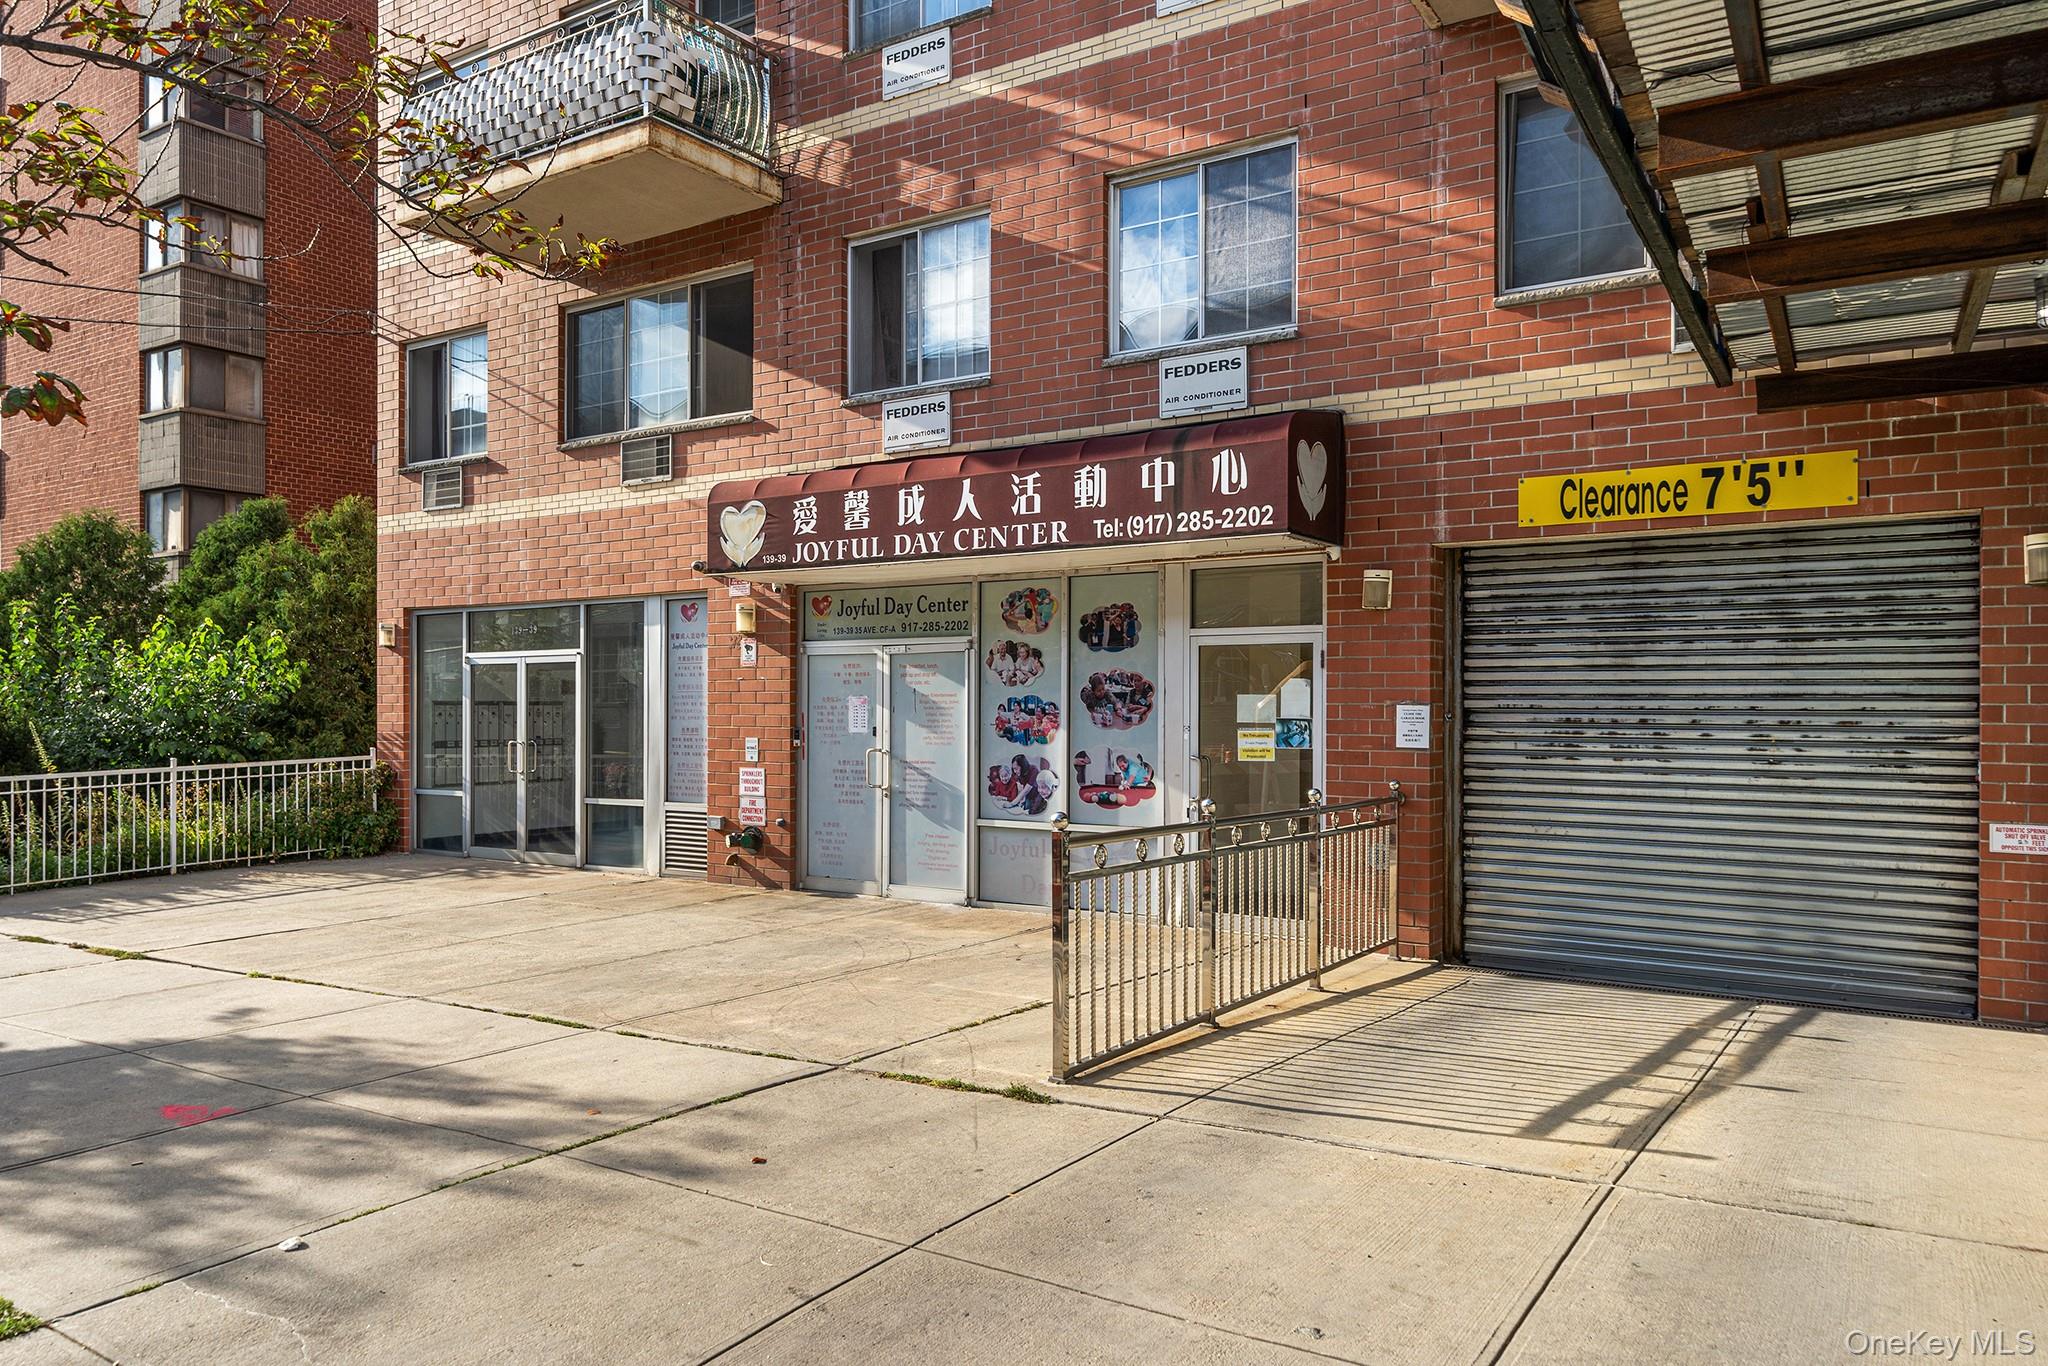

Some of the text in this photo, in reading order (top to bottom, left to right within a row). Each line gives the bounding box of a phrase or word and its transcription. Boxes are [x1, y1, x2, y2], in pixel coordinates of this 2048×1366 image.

[886, 37, 946, 65] FEDDERS
[886, 64, 945, 87] AIR CONDITIONER
[1164, 357, 1242, 379] FEDDERS
[1164, 388, 1242, 404] AIR CONDITIONER
[886, 401, 946, 420] FEDDERS
[900, 427, 946, 440] CONDITIONER
[1559, 478, 1688, 520] Clearance
[1093, 504, 1274, 539] Tel: (917) 285-2202
[792, 520, 1070, 564] JOYFUL DAY CENTER
[761, 553, 787, 563] 139-39
[837, 594, 969, 620] Joyful Day Center
[833, 626, 854, 635] 139-39
[901, 620, 969, 633] 917-285-2202
[743, 785, 760, 793] BUILDING
[741, 807, 764, 815] DEPARTMENT
[742, 814, 763, 823] CONNECTION
[989, 835, 1047, 861] Joyful
[1021, 873, 1048, 896] Da
